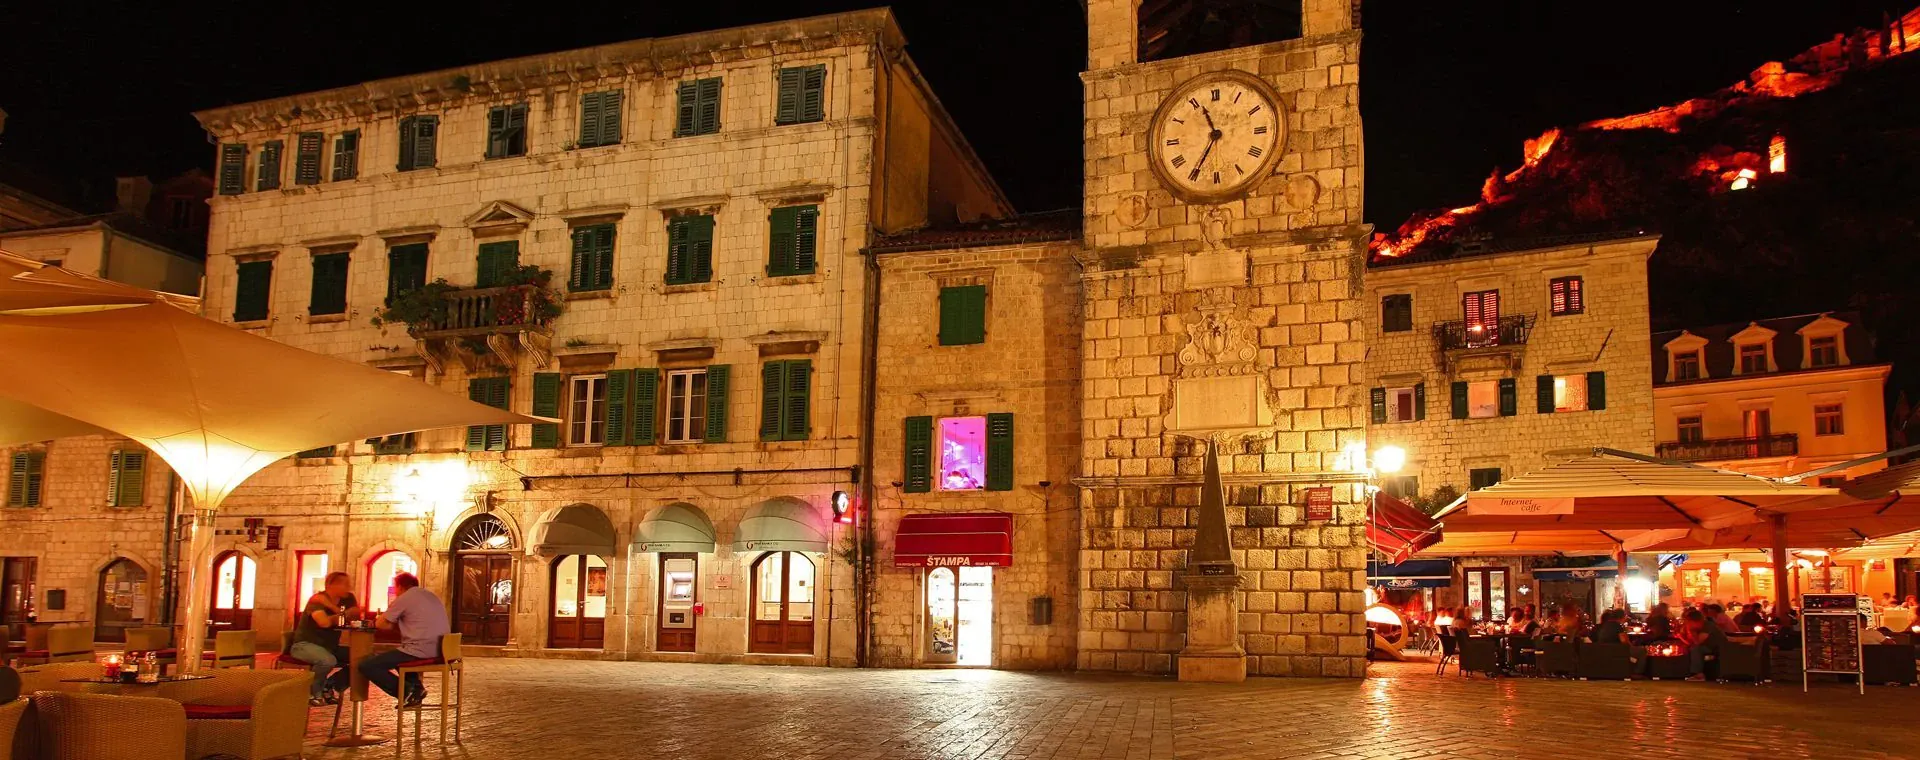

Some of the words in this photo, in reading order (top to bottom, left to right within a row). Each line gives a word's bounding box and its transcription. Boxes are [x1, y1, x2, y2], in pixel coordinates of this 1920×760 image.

[1211, 89, 1220, 102] XII
[1234, 92, 1241, 104] I
[1189, 98, 1200, 110] XI
[1248, 105, 1260, 116] II
[1254, 126, 1267, 134] III
[1500, 498, 1533, 506] Internet
[1520, 504, 1542, 512] caffe
[926, 555, 971, 566] ŠTAMPA
